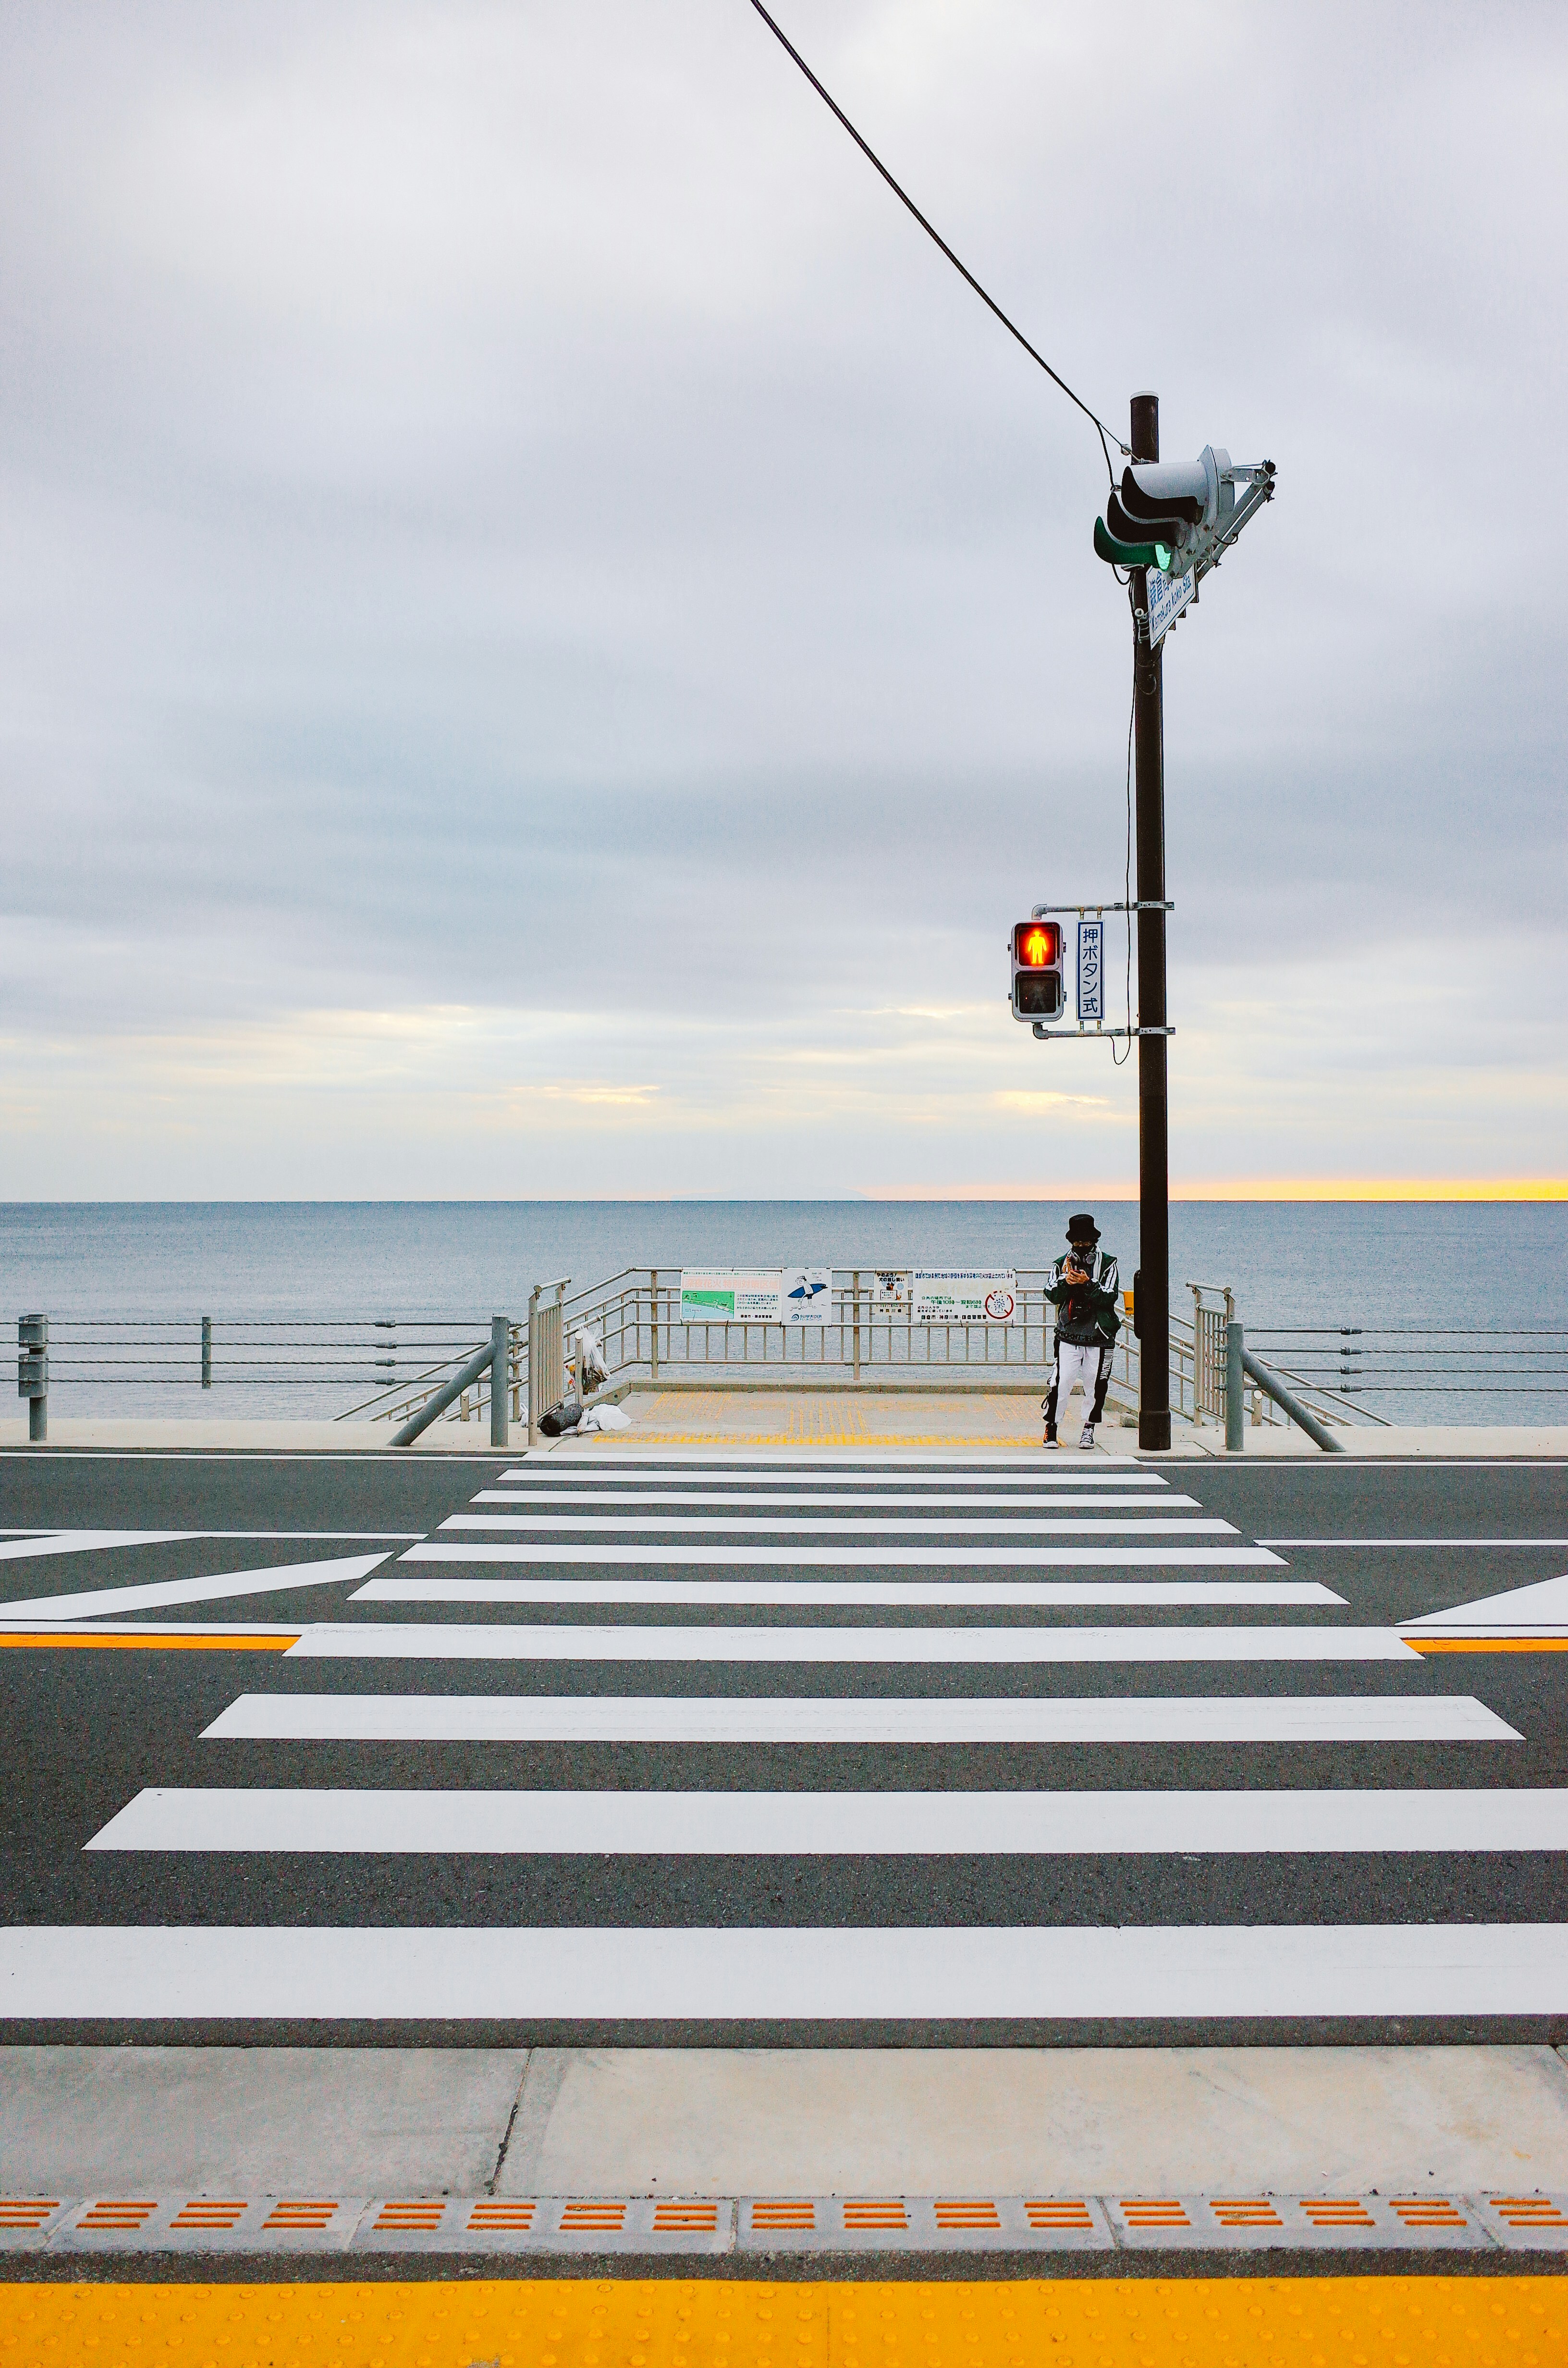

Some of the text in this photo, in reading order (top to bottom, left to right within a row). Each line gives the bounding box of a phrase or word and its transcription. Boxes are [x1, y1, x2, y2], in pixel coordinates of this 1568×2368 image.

[1082, 928, 1098, 1013] 押ボタン式
